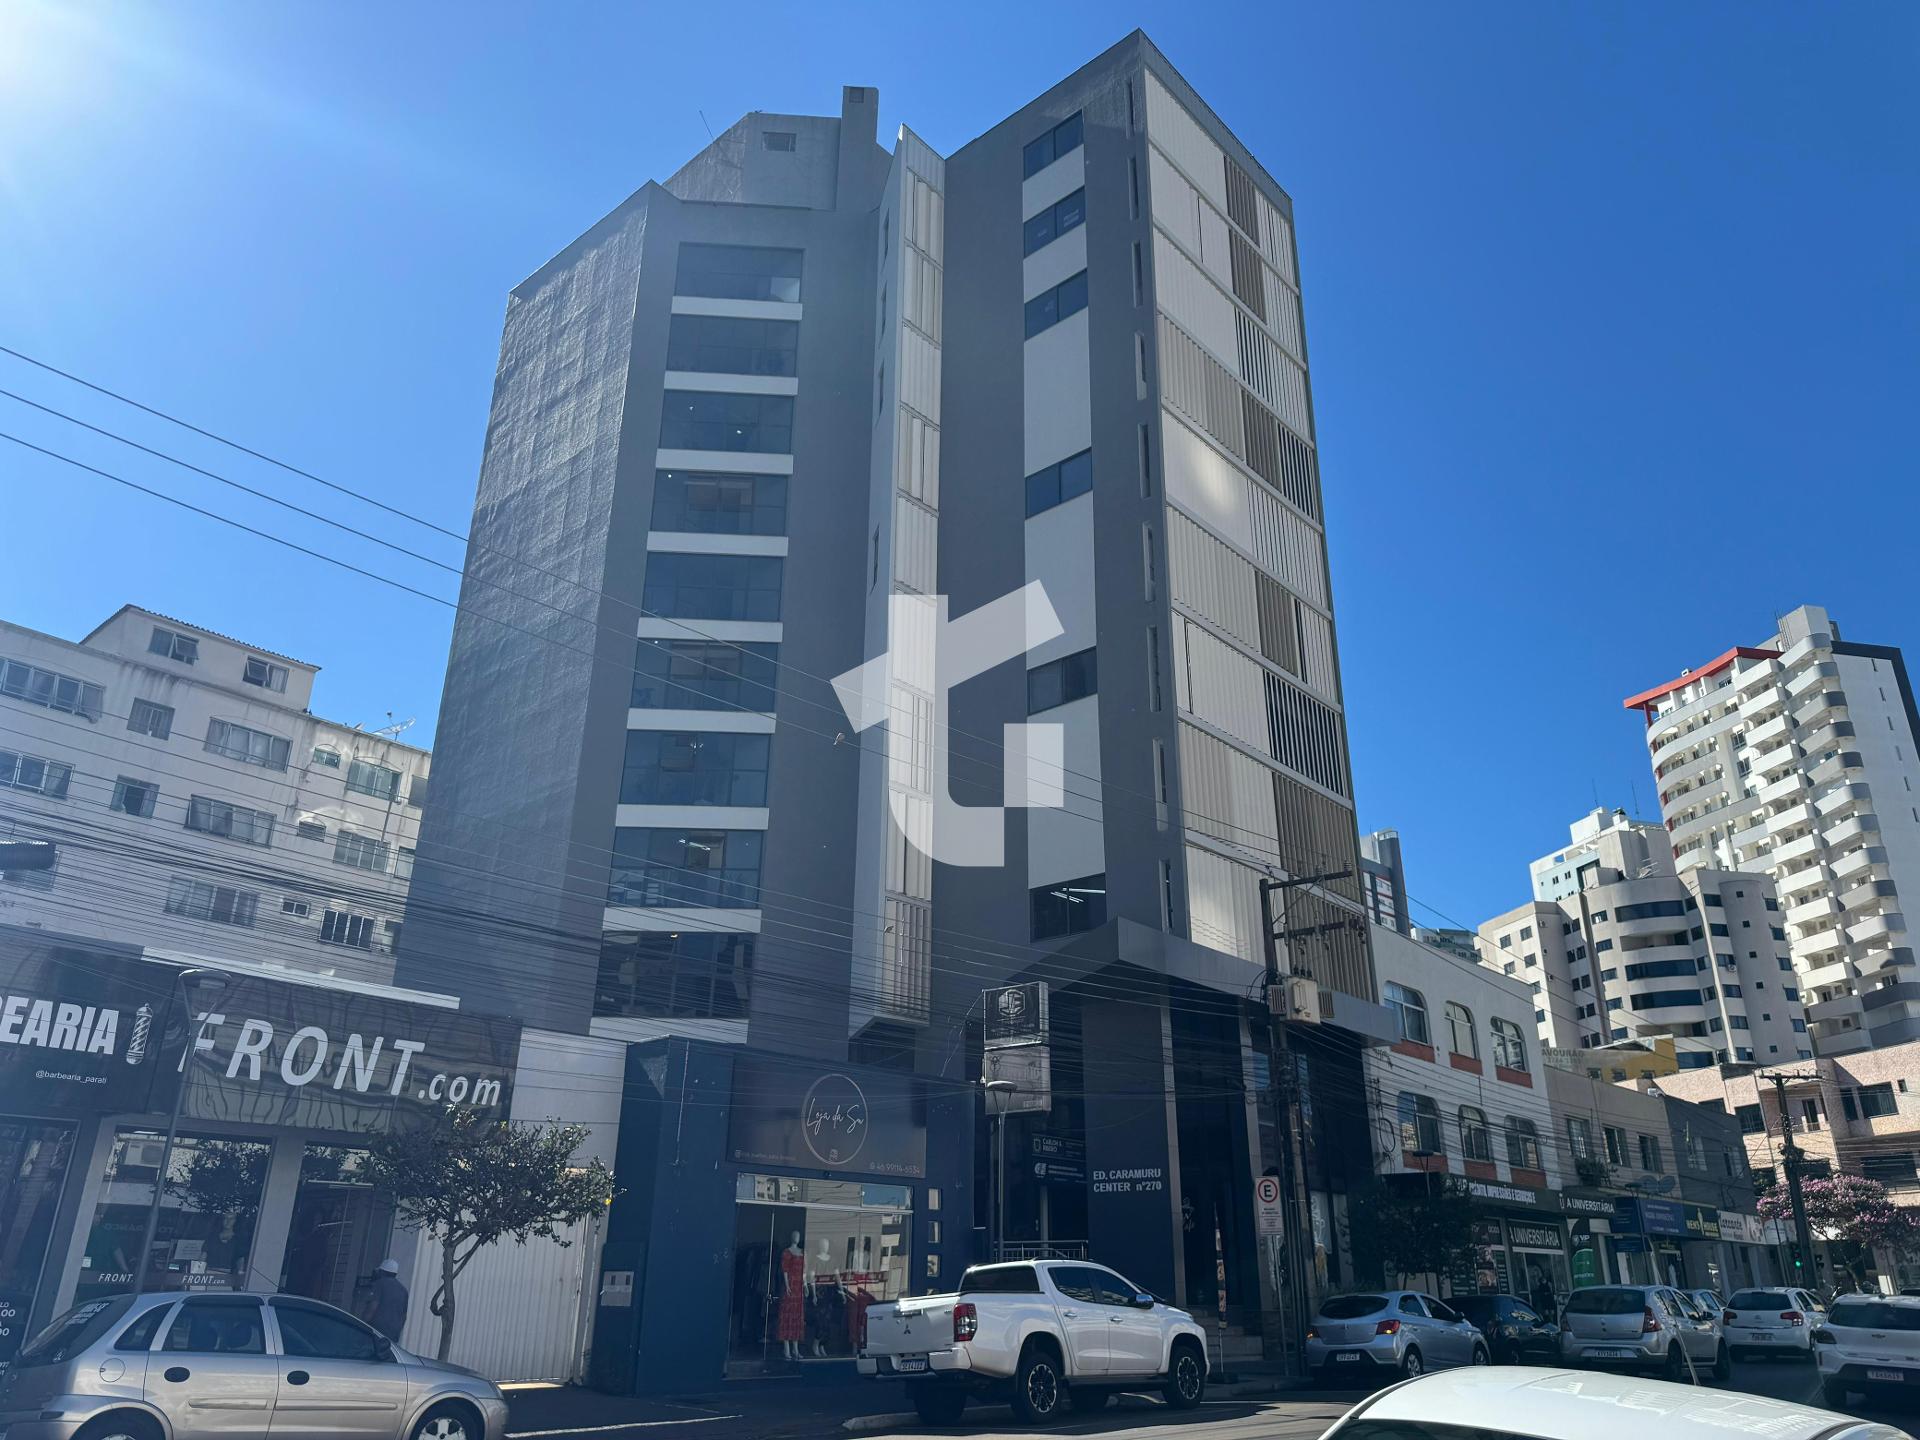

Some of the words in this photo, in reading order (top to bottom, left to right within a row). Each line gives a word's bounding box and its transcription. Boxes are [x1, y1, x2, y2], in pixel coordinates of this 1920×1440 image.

[0, 996, 119, 1055] EARIA
[807, 1097, 830, 1136] Loja
[832, 1105, 843, 1128] da
[1093, 1171, 1108, 1180] ED.
[1109, 1168, 1161, 1180] CARAMURU
[1093, 1182, 1131, 1193] CENTER
[1264, 1184, 1273, 1198] E
